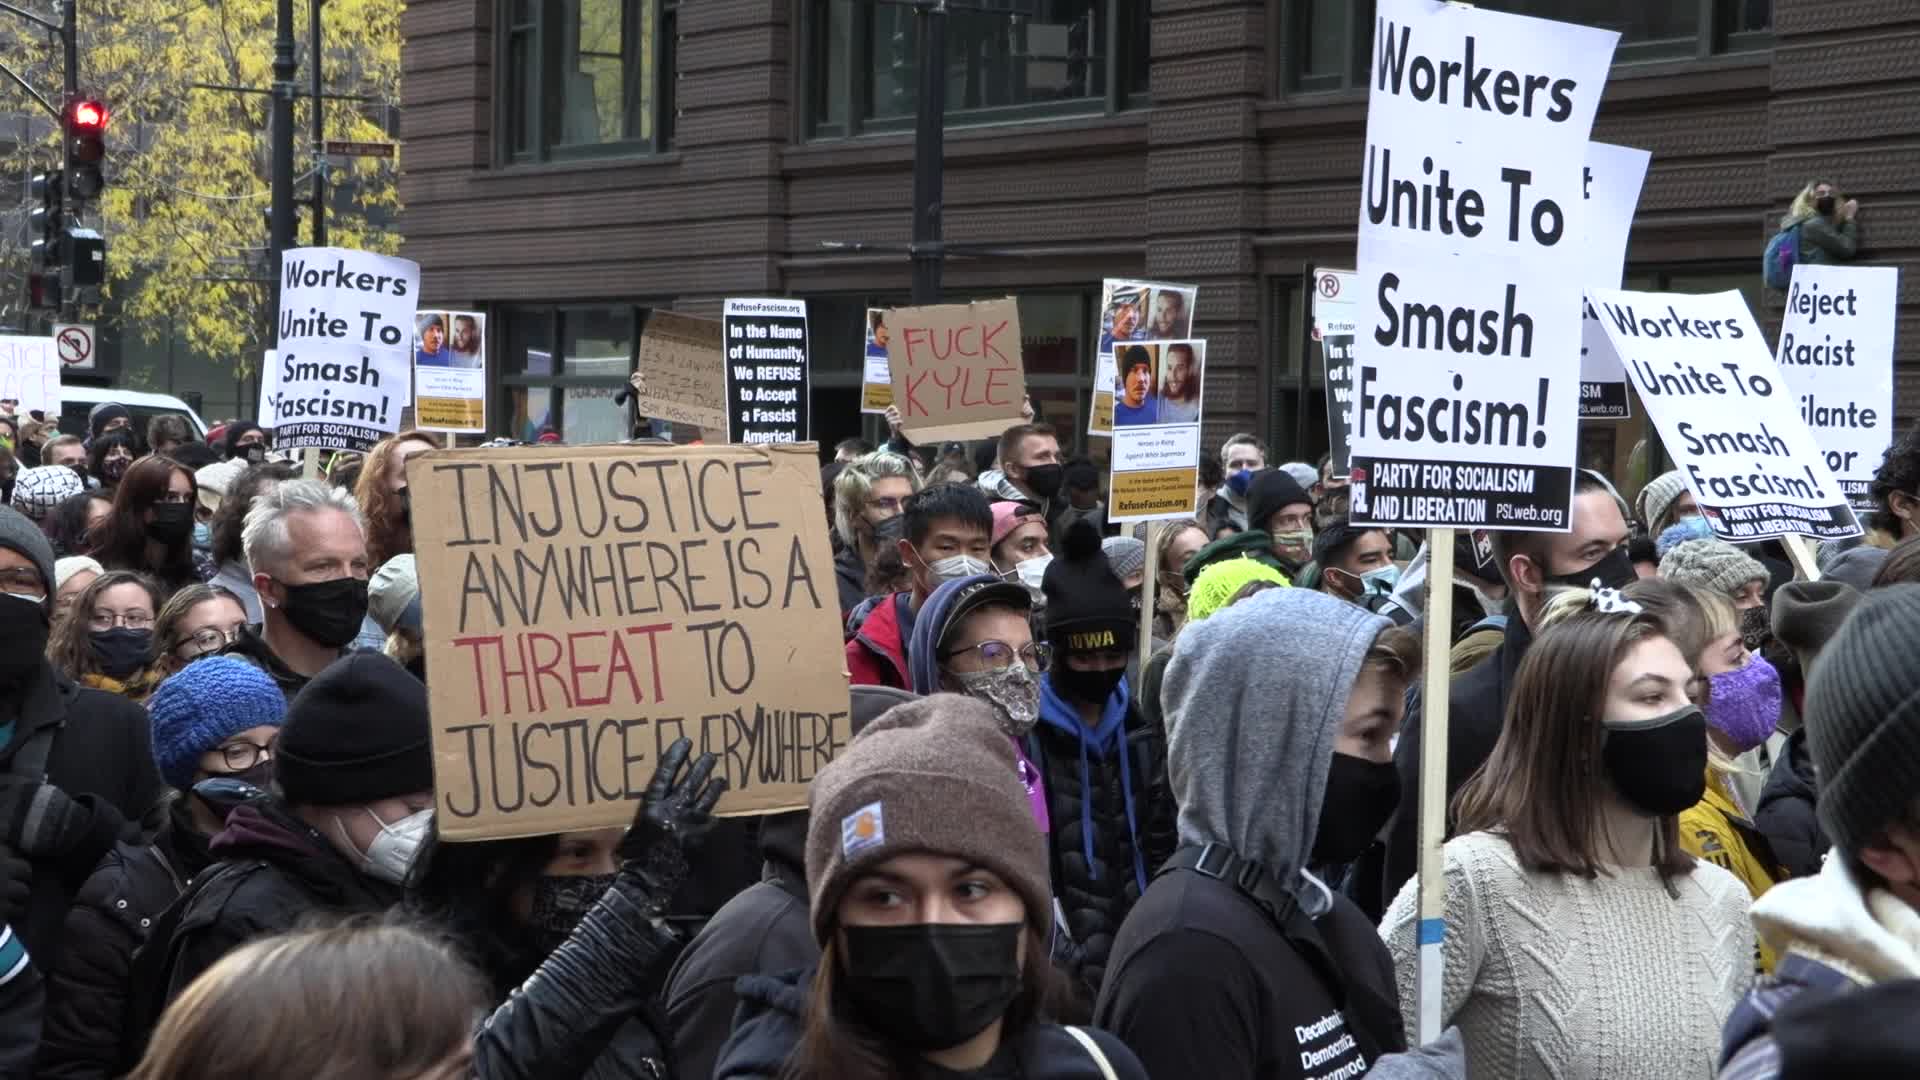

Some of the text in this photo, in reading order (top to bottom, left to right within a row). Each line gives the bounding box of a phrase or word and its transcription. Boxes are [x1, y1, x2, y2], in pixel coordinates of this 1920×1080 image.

[1378, 16, 1577, 123] Workers
[1367, 144, 1564, 246] Unite To
[286, 260, 407, 297] Workers
[731, 302, 801, 313] RefuseFascism.org
[1374, 272, 1534, 358] Smash
[1788, 281, 1857, 325] Reject
[280, 308, 402, 345] Unite To
[730, 323, 743, 338] In
[746, 323, 767, 338] the
[770, 324, 802, 339] Name
[1603, 302, 1744, 340] Workers
[729, 345, 805, 363] of Humanity,
[903, 320, 1009, 367] FUCK
[1329, 344, 1343, 359] In
[1781, 332, 1855, 367] Racist
[282, 353, 380, 387] Smash
[733, 366, 802, 381] We REFUSE
[1329, 366, 1344, 381] of
[1632, 359, 1773, 397] Unite To
[275, 388, 389, 425] Fascism!
[740, 387, 797, 404] to Accept
[906, 366, 1017, 417] KYLE
[1359, 366, 1550, 449] Fascism!
[742, 408, 797, 422] a Fascist
[1580, 404, 1623, 416] SLweb.org
[1801, 394, 1877, 429] ilante
[279, 424, 379, 441] PARTY FOR SOCIALISM
[292, 436, 347, 449] LIBERATION
[743, 429, 796, 443] America!
[1677, 422, 1790, 457] Smash
[1373, 463, 1535, 493] PARTY FOR SOCIALISM
[1821, 450, 1858, 473] or
[1686, 463, 1825, 500] Fascism!
[433, 458, 780, 547] INJUSTICE
[1371, 496, 1563, 526] AND LIBERATION PSLweb.org
[1721, 504, 1833, 522] PARTY FOR SOCIALISM
[1731, 521, 1757, 536] AND
[1754, 519, 1815, 534] LIBERATION
[459, 534, 822, 633] ANYWHERE IS A
[453, 619, 755, 718] THREAT TO
[445, 717, 649, 819] JUSTICE
